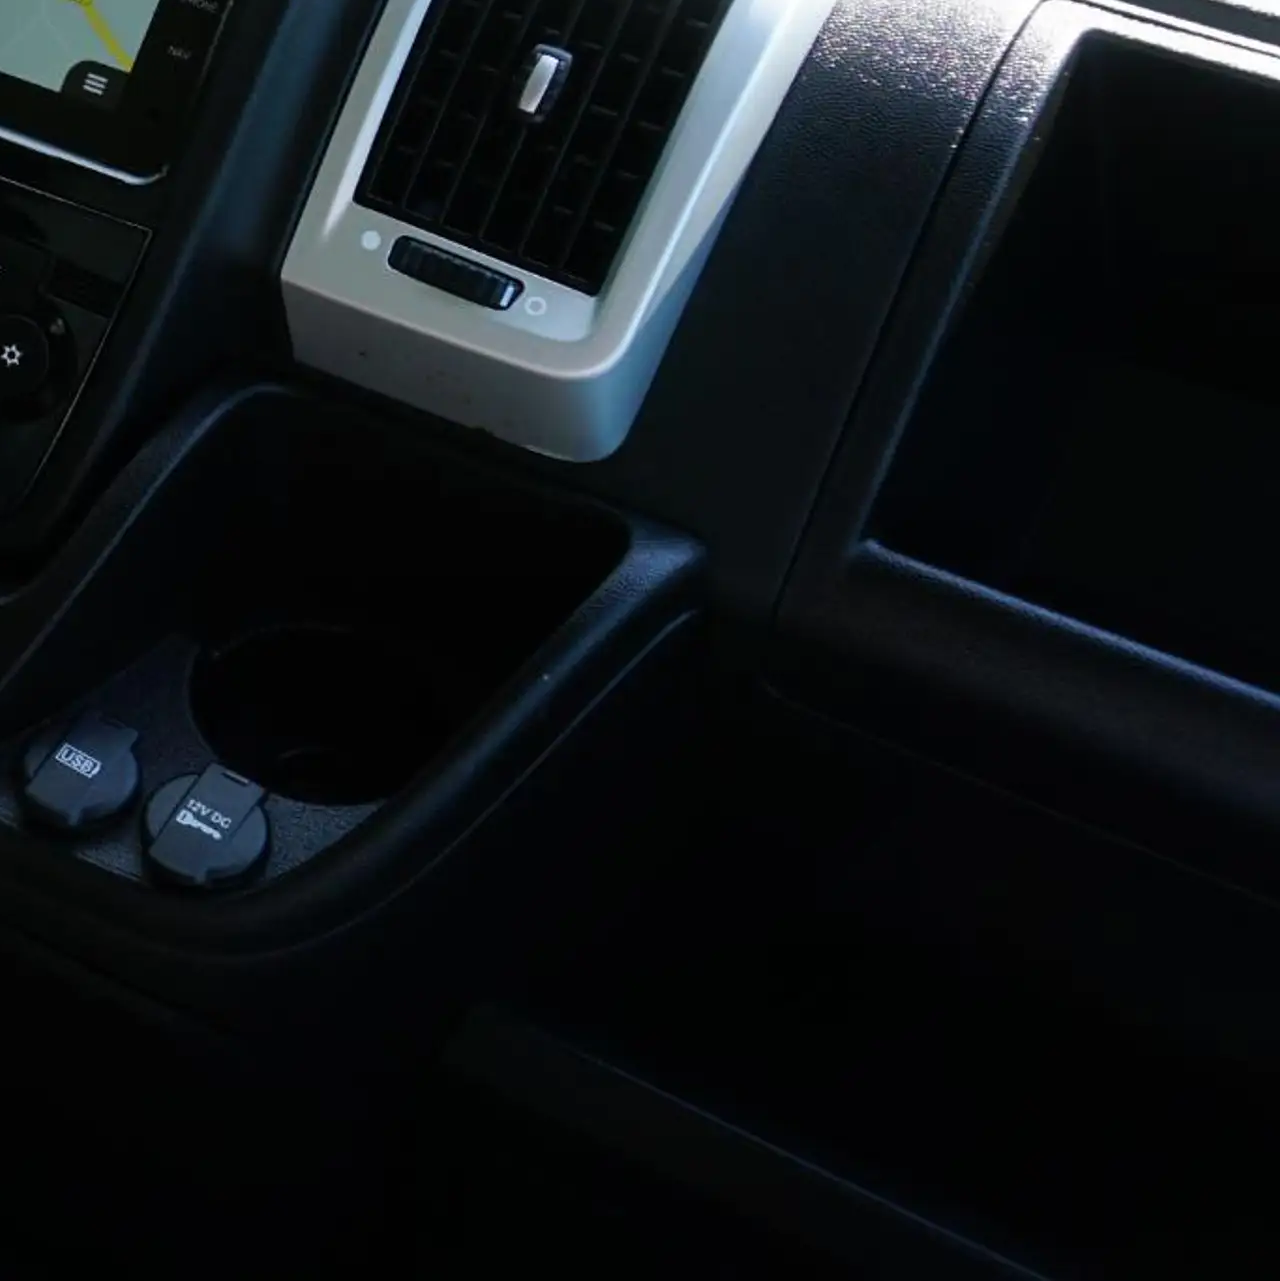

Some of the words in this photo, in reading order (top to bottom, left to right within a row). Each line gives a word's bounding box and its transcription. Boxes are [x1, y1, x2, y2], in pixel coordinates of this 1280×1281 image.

[60, 747, 95, 774] USB
[187, 799, 214, 816] 12V
[211, 811, 232, 829] DC
